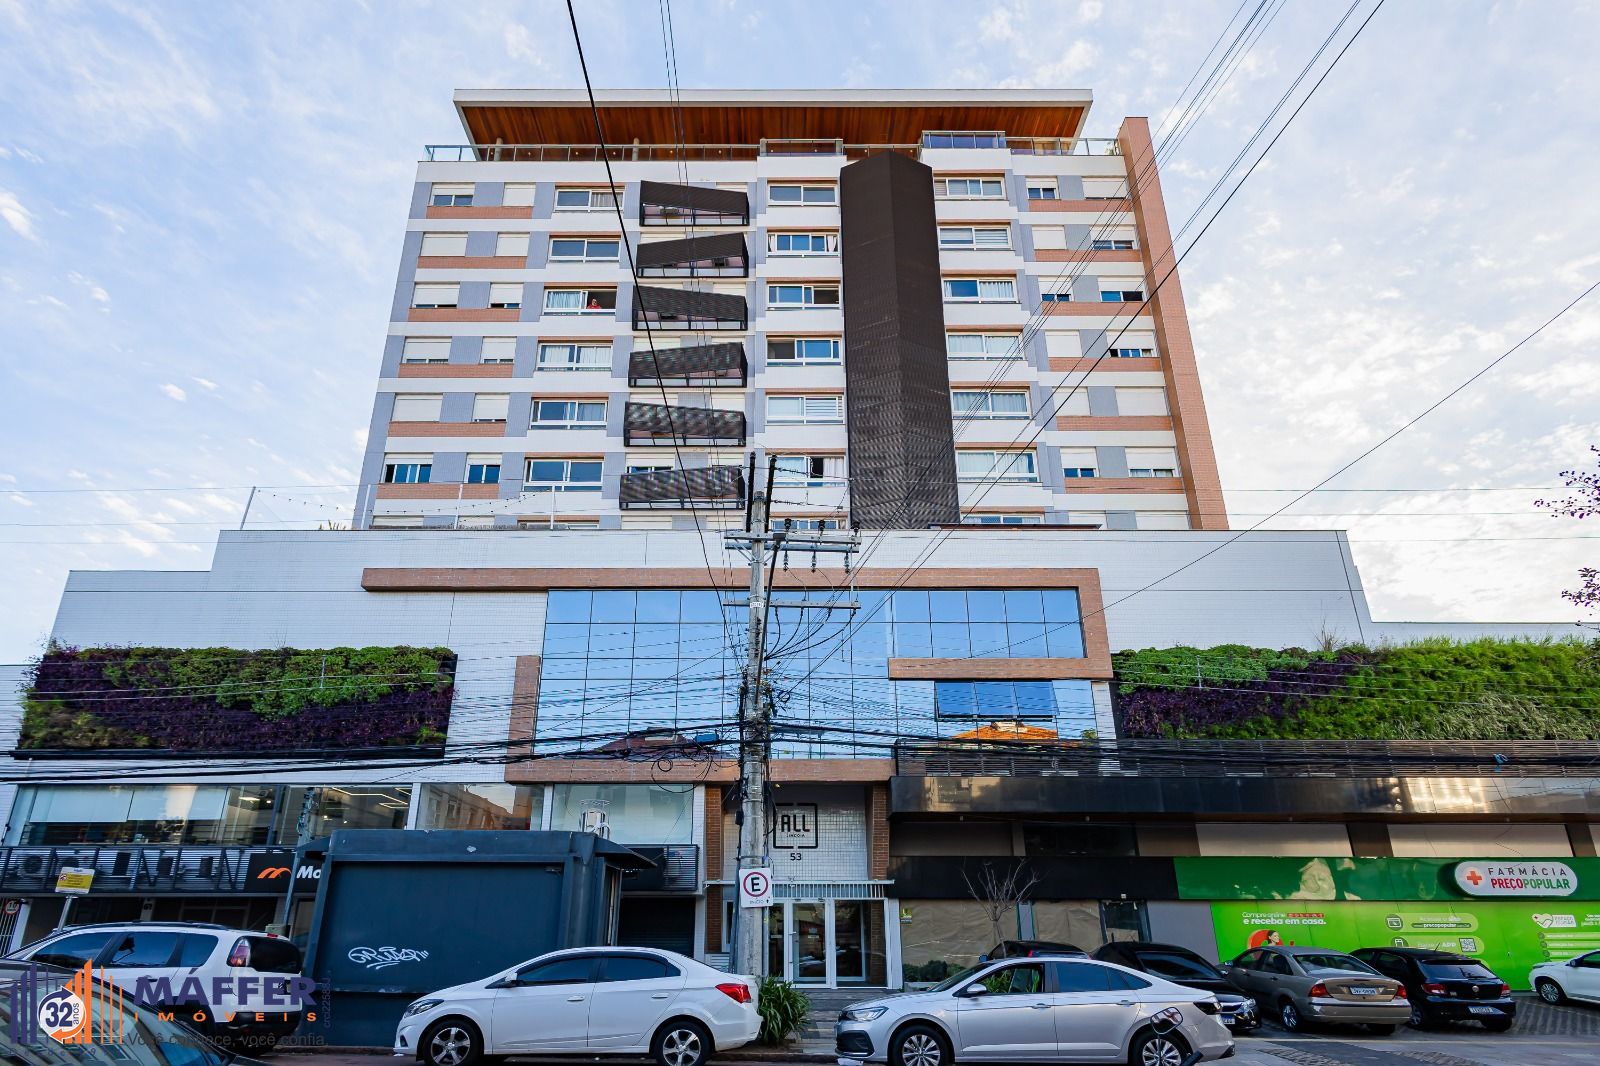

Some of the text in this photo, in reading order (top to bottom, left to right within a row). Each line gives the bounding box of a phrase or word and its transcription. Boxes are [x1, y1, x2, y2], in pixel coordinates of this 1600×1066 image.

[781, 814, 811, 832] ALL
[789, 852, 802, 861] 53
[1487, 865, 1568, 876] FARMÁCIA
[750, 876, 761, 892] E
[1251, 917, 1284, 925] receba
